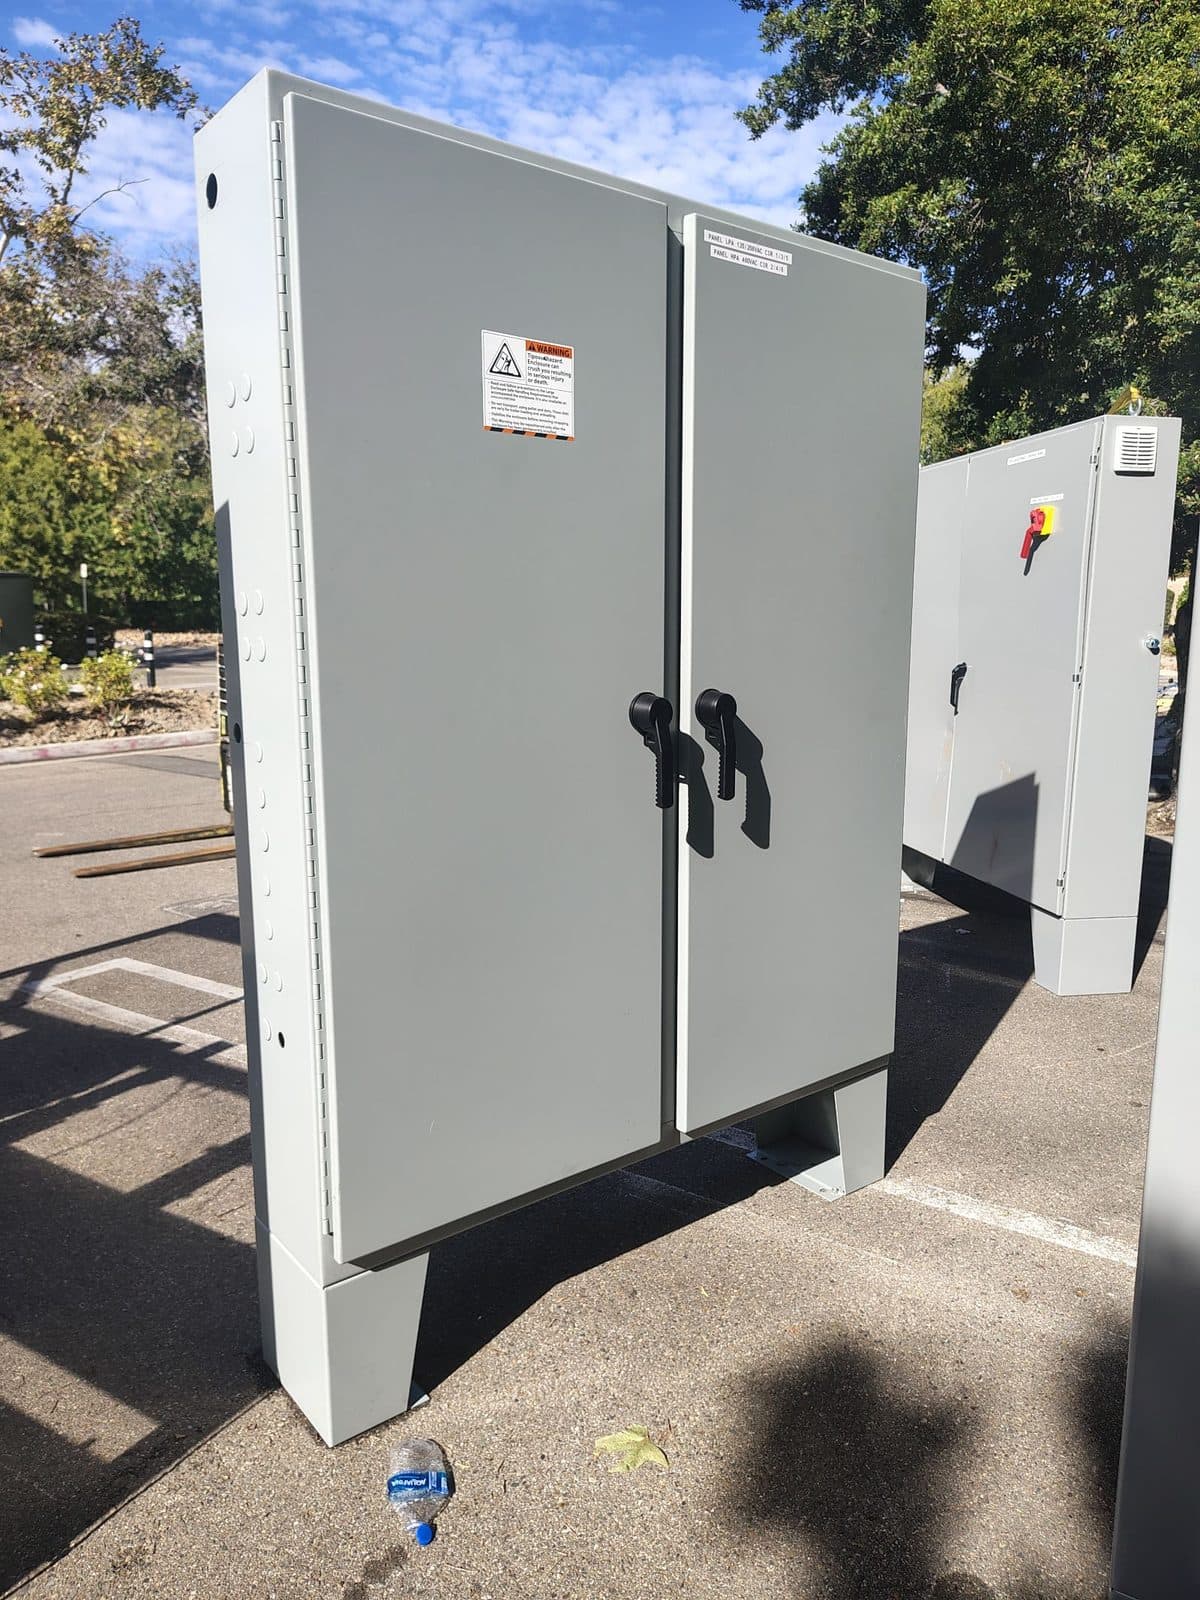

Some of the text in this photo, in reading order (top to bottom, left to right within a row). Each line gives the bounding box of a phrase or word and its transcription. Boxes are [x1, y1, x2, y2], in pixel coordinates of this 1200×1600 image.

[708, 234, 723, 243] PANEL
[714, 249, 728, 258] PANEL
[537, 344, 570, 358] WARNING
